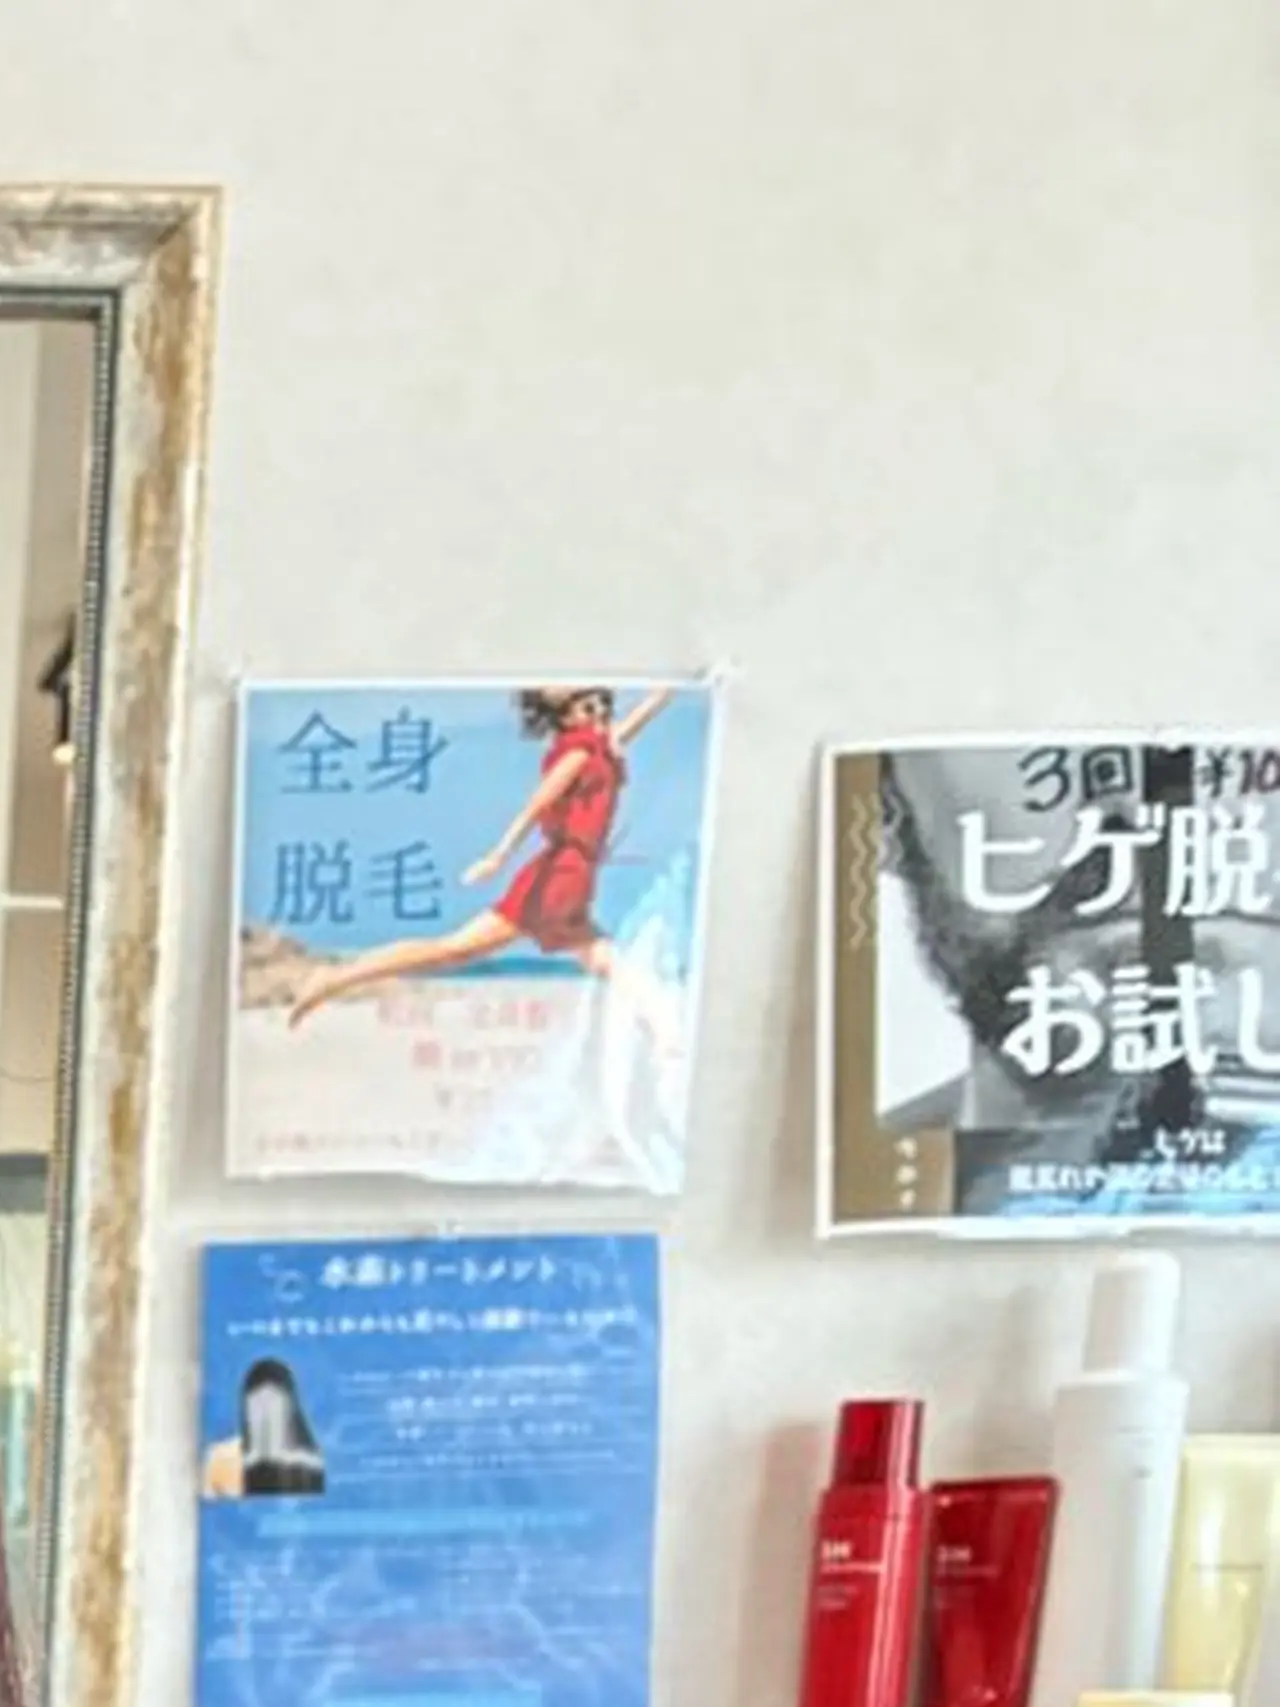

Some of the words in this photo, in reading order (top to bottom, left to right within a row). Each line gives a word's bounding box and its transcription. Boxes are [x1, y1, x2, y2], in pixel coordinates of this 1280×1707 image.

[277, 706, 450, 796] 全身
[1017, 745, 1132, 812] 3回
[268, 840, 445, 926] 脱毛
[957, 803, 1280, 917] ヒゲ脱
